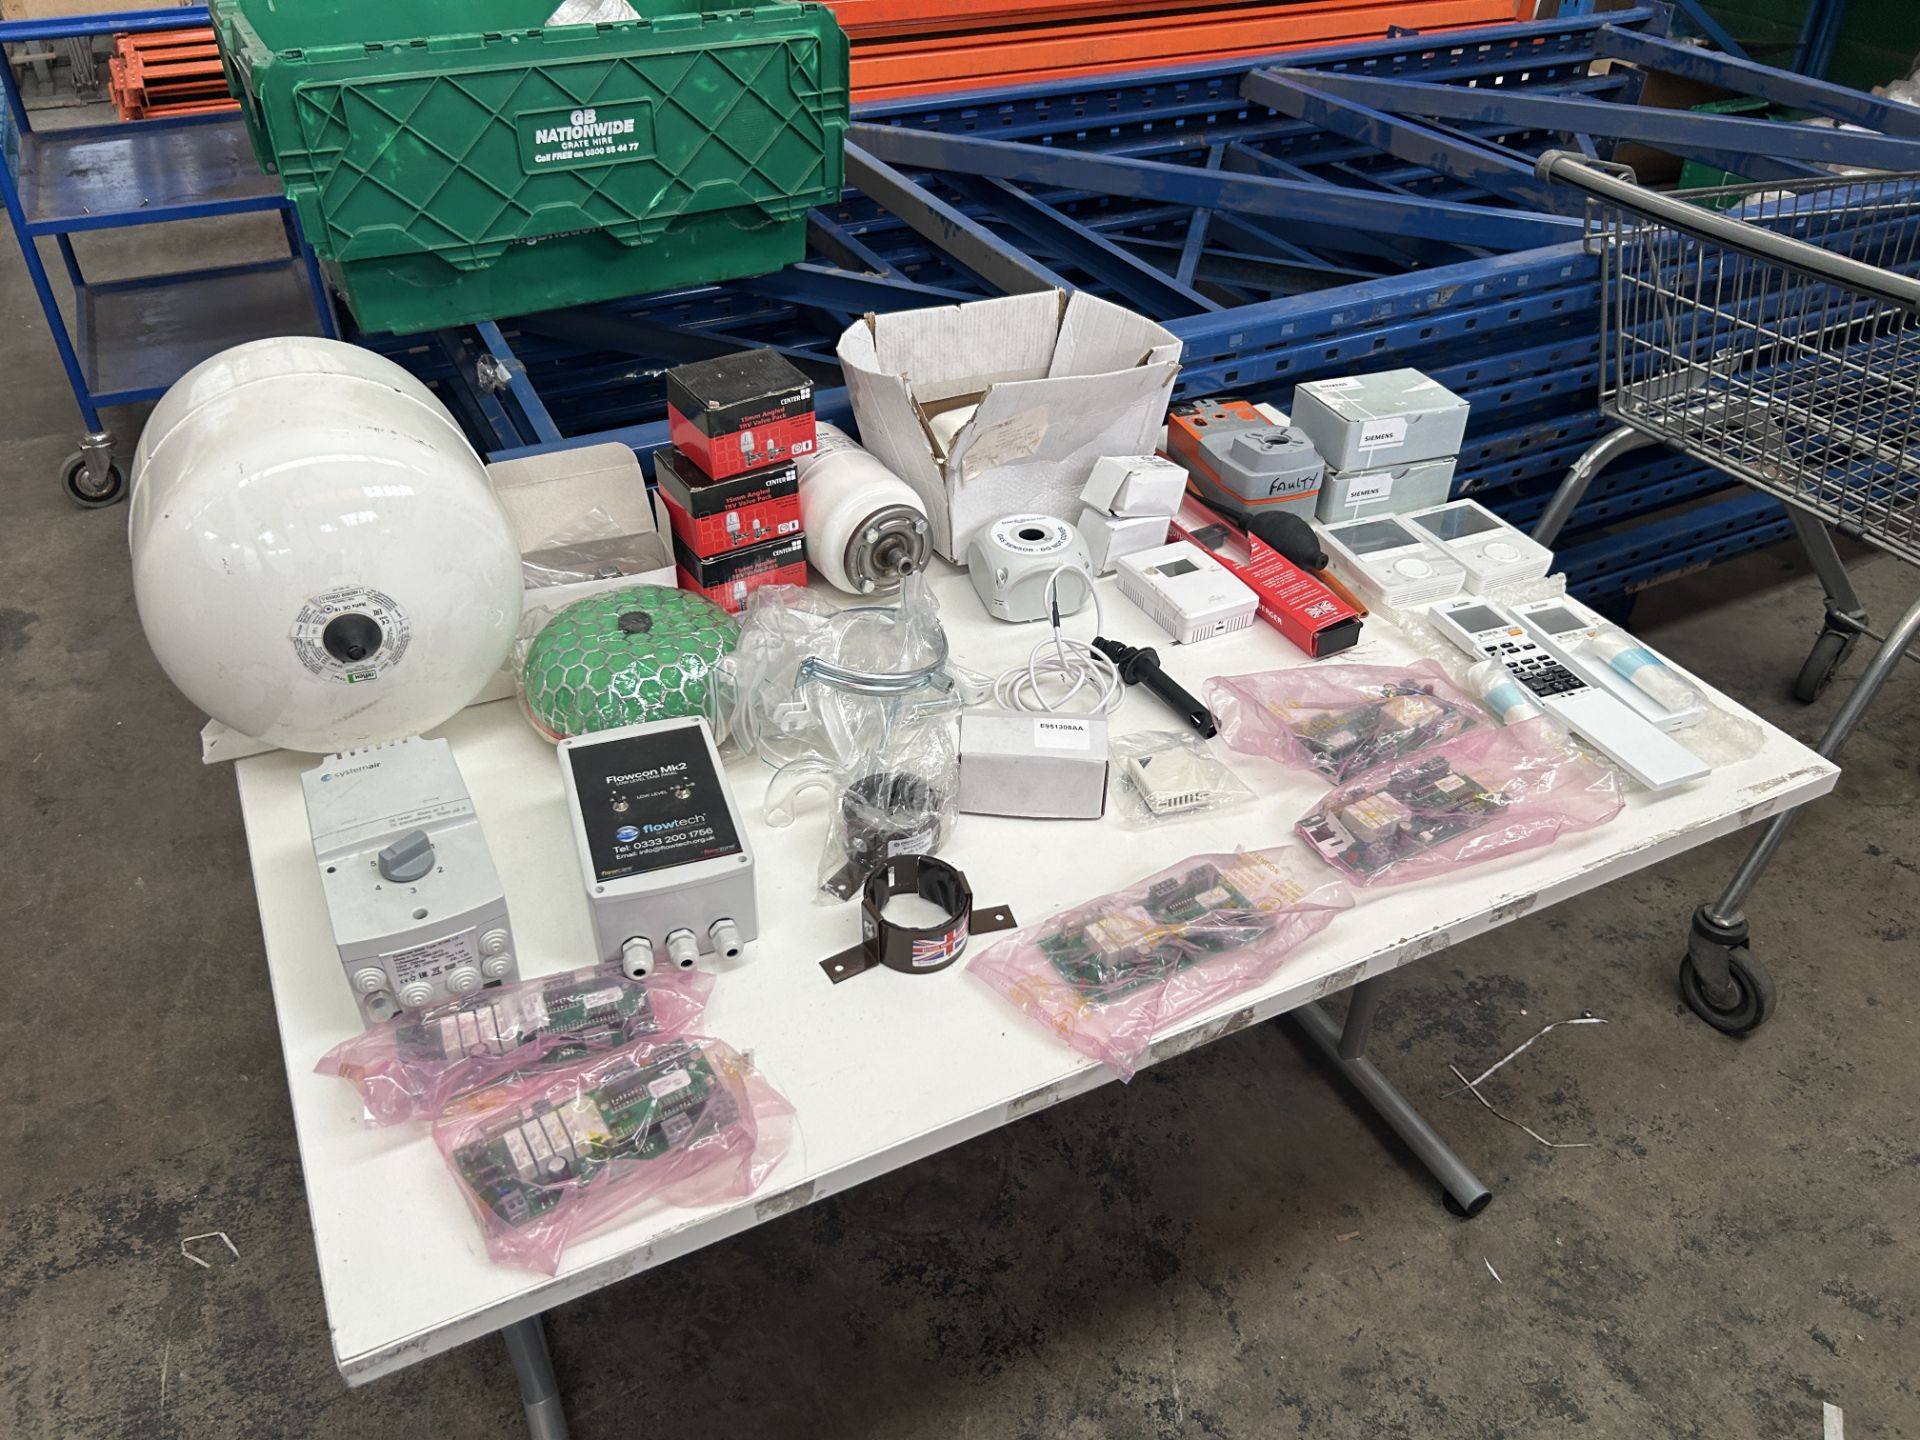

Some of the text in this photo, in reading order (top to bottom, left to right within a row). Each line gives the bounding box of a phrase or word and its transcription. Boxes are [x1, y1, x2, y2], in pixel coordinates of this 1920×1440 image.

[570, 109, 596, 125] GB
[536, 118, 634, 144] NATIONWIDE
[561, 136, 614, 150] CRATE HIRE
[535, 152, 550, 162] Call
[552, 150, 572, 161] FREE
[585, 148, 604, 157] 0800
[617, 144, 627, 153] 44
[629, 143, 639, 151] 77
[780, 395, 800, 406] CENTER
[1364, 432, 1394, 442] SIEMENS
[766, 476, 786, 486] CENTER
[1350, 488, 1379, 497] SIEMENS
[772, 547, 792, 557] CENTER
[334, 762, 381, 778] systemair
[606, 762, 688, 784] Flowcon Mk2
[642, 814, 705, 834] flowtech
[613, 843, 631, 854] Tel:
[633, 838, 663, 850] 0333
[665, 833, 686, 843] 200
